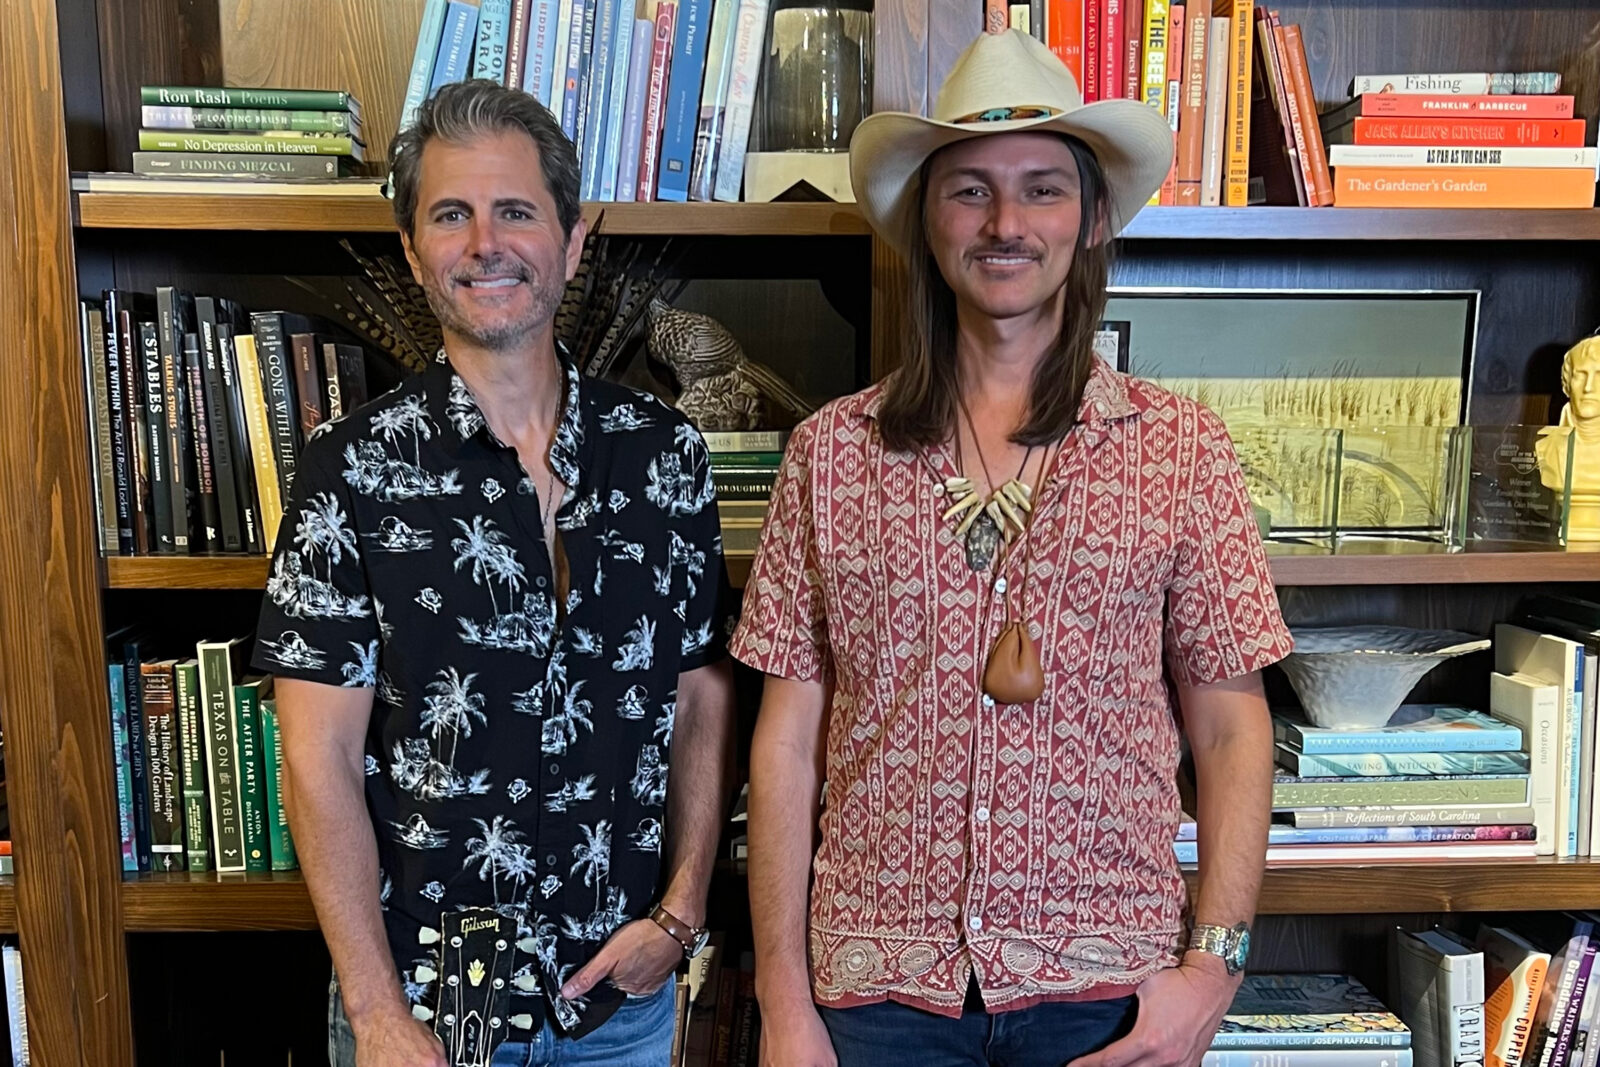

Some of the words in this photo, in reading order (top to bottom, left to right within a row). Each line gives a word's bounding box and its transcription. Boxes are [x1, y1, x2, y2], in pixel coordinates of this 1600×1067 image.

[536, 2, 548, 50] HIDDEN
[1149, 16, 1164, 47] THE
[1192, 17, 1205, 60] COOKING
[478, 20, 492, 73] PARA
[1128, 39, 1138, 73] Ernest
[1146, 50, 1163, 84] BEE
[159, 88, 189, 103] Ron
[195, 90, 230, 104] Rash
[242, 92, 288, 105] Poems
[1190, 72, 1202, 106] STORM
[1405, 76, 1462, 92] Fishing
[207, 114, 252, 123] LOADING
[1288, 92, 1300, 121] SOUL
[1422, 101, 1469, 109] FRANKLIN
[1479, 102, 1527, 111] BARBECUE
[184, 139, 200, 150] No
[202, 140, 262, 152] Depression
[264, 141, 275, 152] in
[278, 142, 317, 153] Heaven
[1452, 126, 1504, 140] KITCHEN
[181, 160, 236, 170] FINDING
[240, 161, 294, 172] MEZCAL
[1427, 150, 1435, 163] AS
[1450, 150, 1459, 163] AS
[1347, 178, 1371, 191] The
[1374, 179, 1439, 192] Gardener's
[1442, 180, 1487, 192] Garden
[93, 324, 105, 373] SEEING
[106, 331, 117, 366] FEVER
[145, 337, 161, 413] STABLES
[164, 354, 174, 392] TALKING
[191, 365, 201, 385] THE
[267, 353, 284, 397] GONE
[96, 378, 108, 418] TEXAS
[109, 370, 120, 409] WITHIN
[194, 389, 205, 420] BIRTH
[113, 413, 122, 428] The
[167, 395, 177, 428] STONES
[274, 400, 290, 436] WITH
[114, 431, 123, 444] Art
[198, 424, 207, 438] OF
[99, 421, 113, 478] HISTORY
[115, 446, 124, 455] of
[280, 440, 294, 468] THE
[116, 456, 126, 485] Ronald
[200, 442, 213, 493] BOURBON
[118, 487, 129, 517] Lockett
[161, 714, 170, 730] The
[211, 690, 227, 740] TEXAS
[241, 698, 250, 718] THE
[146, 715, 158, 745] Design
[180, 708, 190, 747] VEGETABLE
[242, 723, 253, 756] AFTER
[1537, 720, 1550, 764] Occasions
[133, 750, 144, 777] GRITS
[150, 747, 158, 755] in
[161, 731, 171, 764] History
[217, 746, 228, 766] ON
[151, 757, 160, 773] 100
[163, 765, 172, 776] of
[183, 749, 193, 785] COOKBOOK
[245, 761, 256, 794] PARTY
[151, 775, 163, 812] Gardens
[163, 776, 174, 822] Landscape
[220, 789, 235, 834] TABLE
[245, 801, 254, 843] DISCLAFANI
[1345, 811, 1394, 824] Reflections
[1397, 811, 1408, 824] of
[1409, 811, 1435, 821] South
[1438, 811, 1480, 820] Carolina
[460, 916, 500, 939] Gibson
[1550, 960, 1580, 1034] Grandfather
[1574, 977, 1586, 997] THE
[1458, 1007, 1479, 1056] KRAZY
[1560, 997, 1581, 1044] WRITER'S
